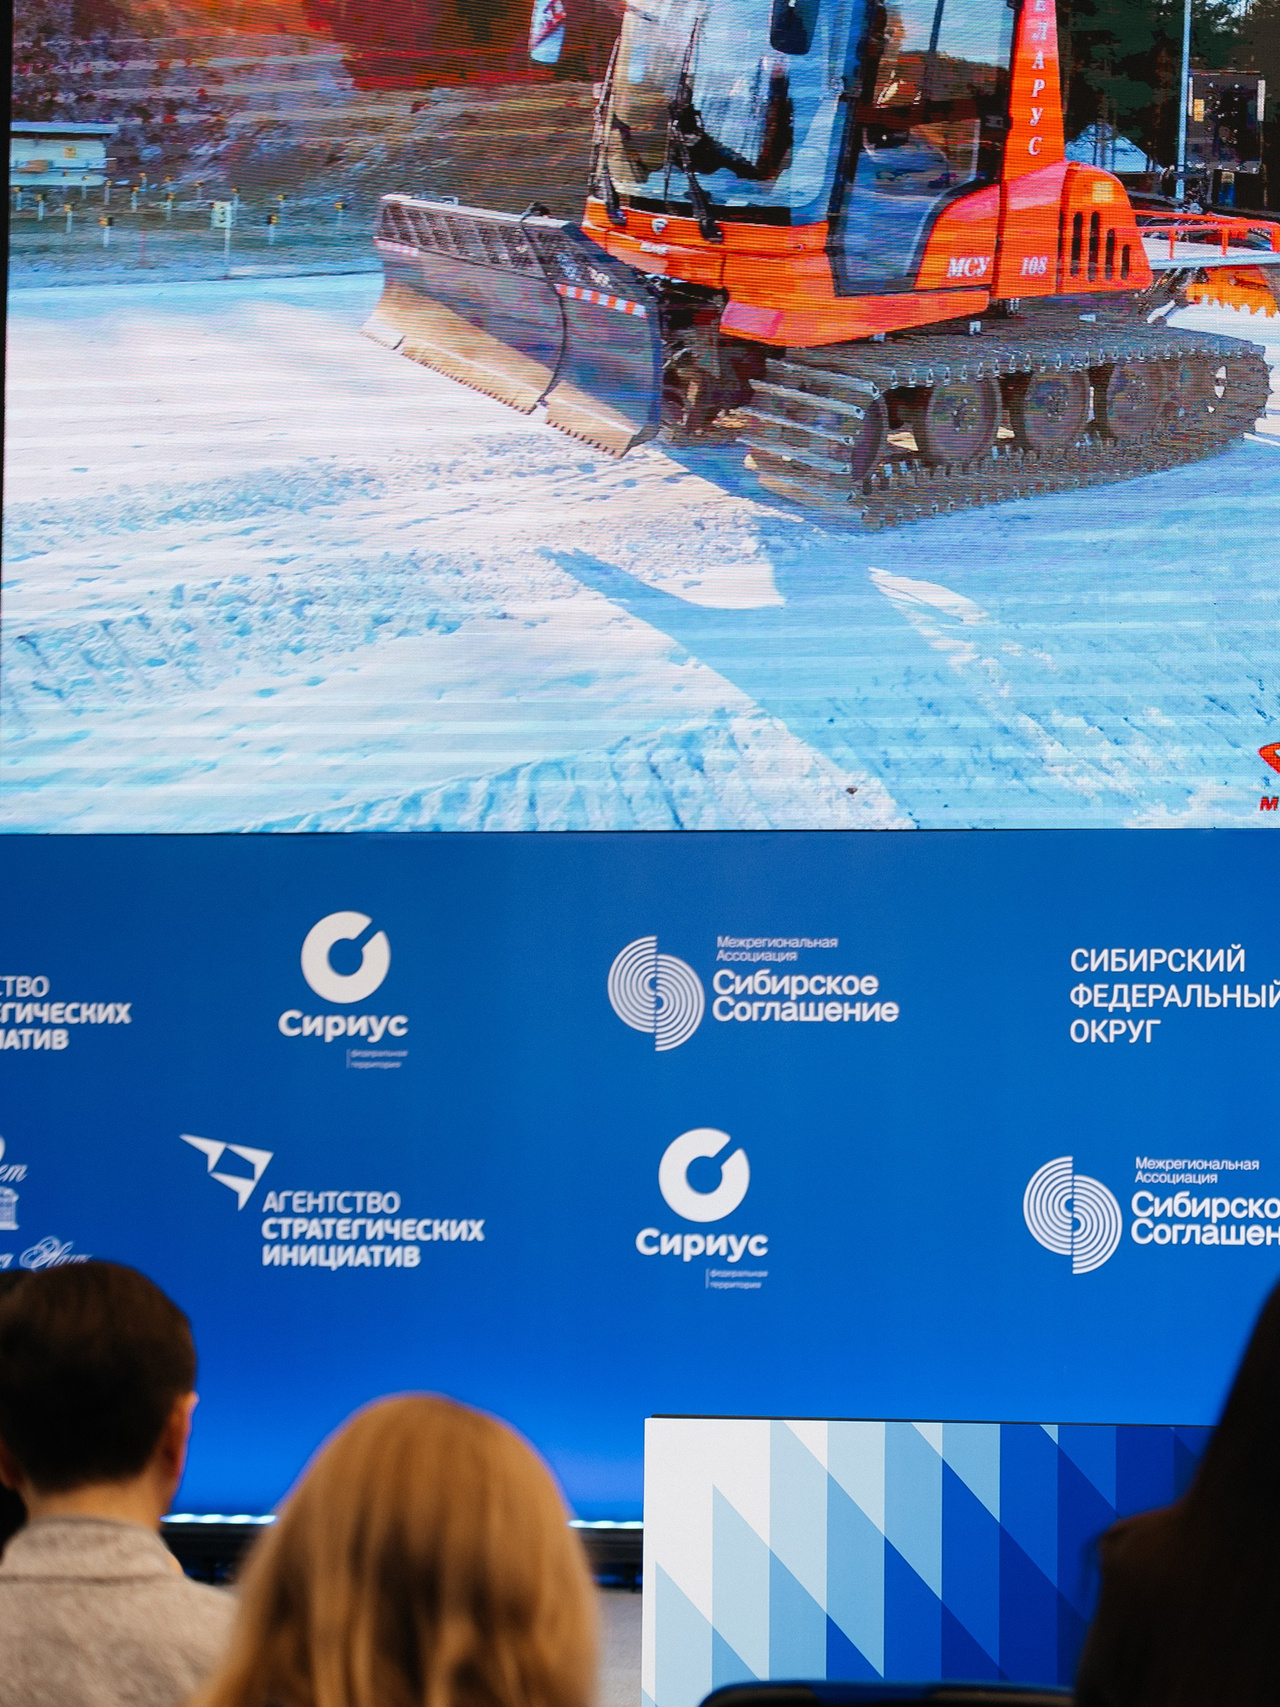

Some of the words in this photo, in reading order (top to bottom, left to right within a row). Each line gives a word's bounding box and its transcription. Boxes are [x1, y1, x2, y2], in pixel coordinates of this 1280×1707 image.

[946, 256, 991, 277] МСУ
[1020, 256, 1048, 275] 108
[717, 936, 839, 949] Межрегиональная
[716, 950, 798, 963] Ассоциация
[1070, 943, 1246, 973] СИБИРСКИЙ
[712, 968, 880, 1000] Сибирское
[0, 1002, 133, 1024] ГИЧЕСКИХ
[712, 996, 900, 1023] Соглашение
[278, 1009, 409, 1043] Сириус
[1069, 1018, 1162, 1044] ОКРУГ
[1135, 1156, 1260, 1171] Межрегиональная
[1134, 1171, 1218, 1185] Ассоциация
[262, 1190, 401, 1214] АГЕНТСТВО
[261, 1217, 486, 1242] СТРАТЕГИЧЕСКИХ
[261, 1244, 421, 1271] ИНИЦИАТИВ
[635, 1227, 769, 1263] Сириус
